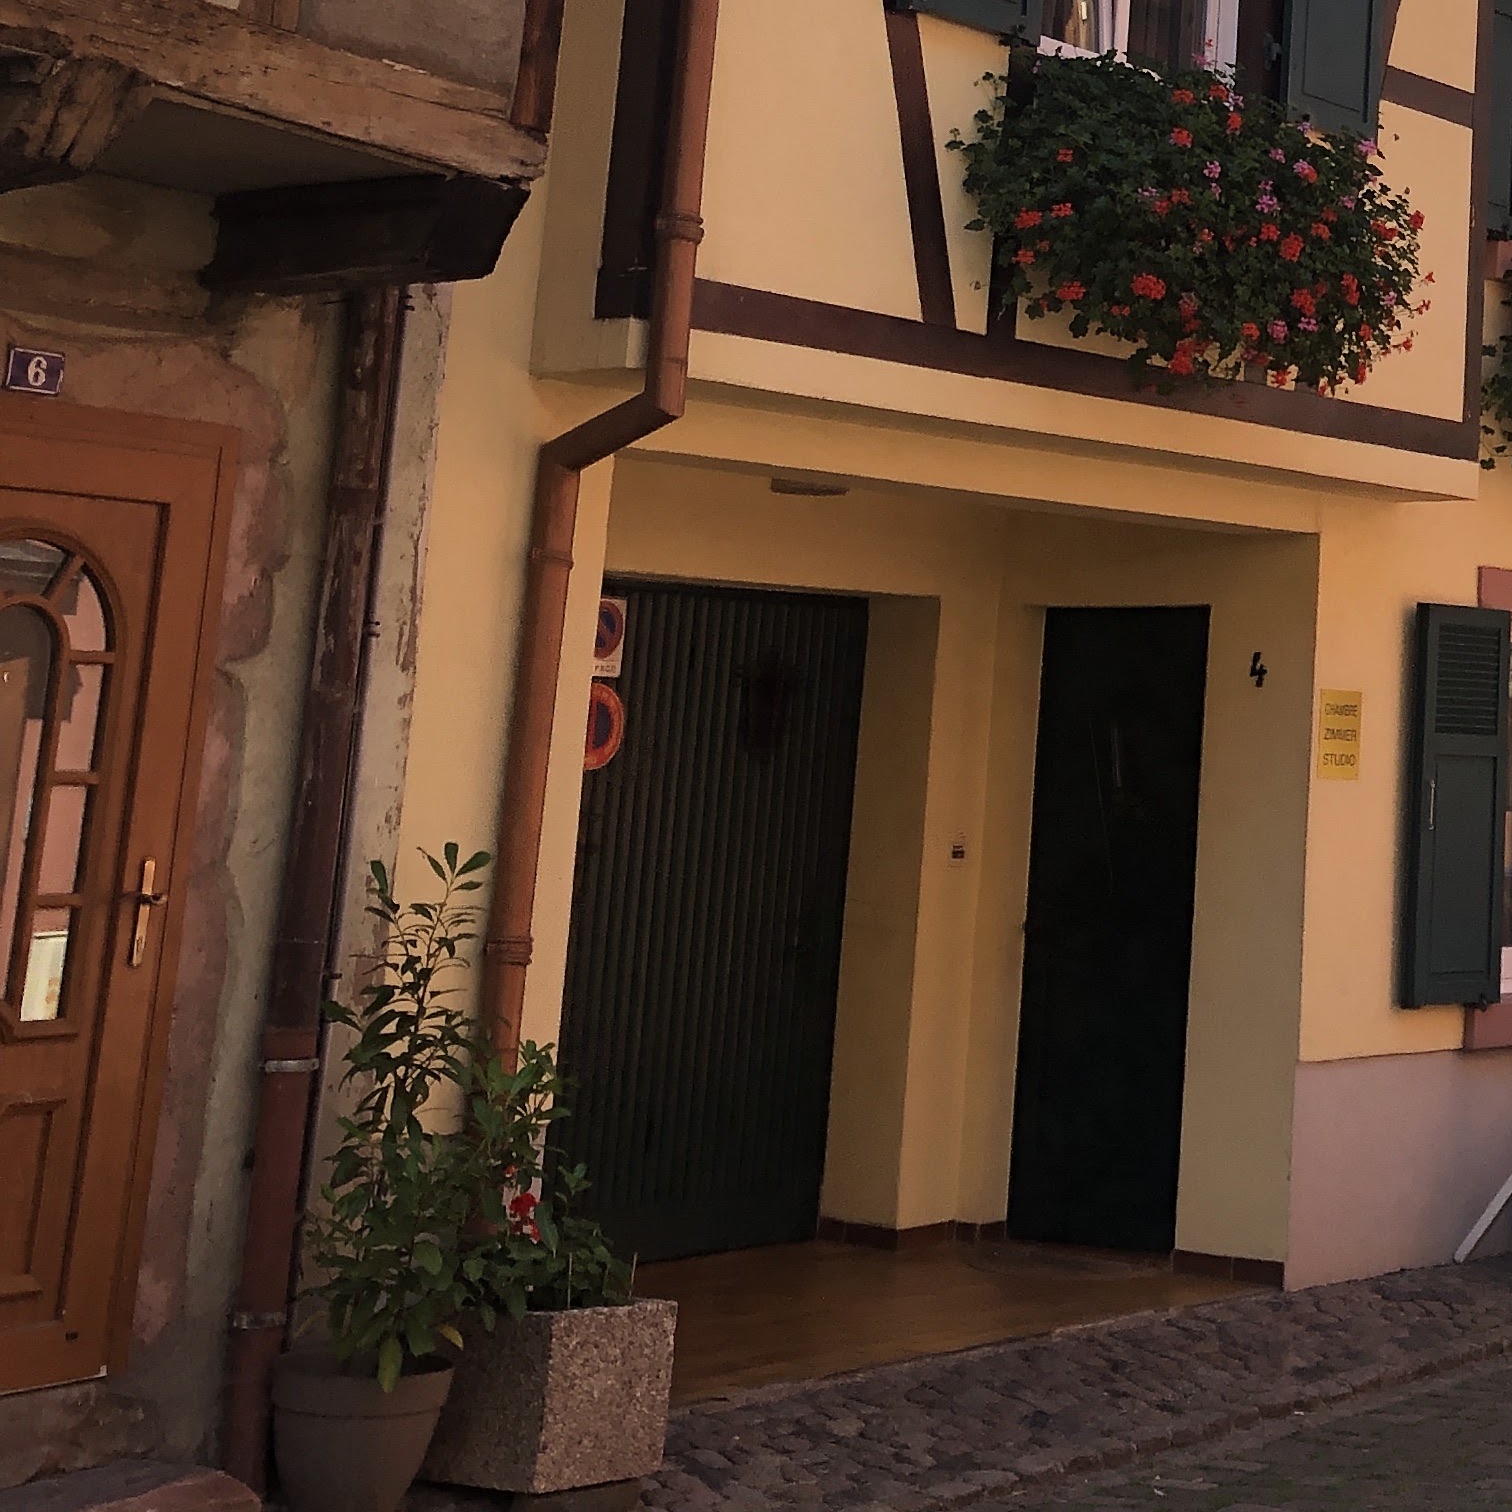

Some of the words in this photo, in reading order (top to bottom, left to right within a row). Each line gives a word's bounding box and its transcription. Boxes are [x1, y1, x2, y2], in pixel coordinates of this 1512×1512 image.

[27, 356, 48, 387] 6
[1249, 651, 1268, 688] 4
[1323, 727, 1358, 742] ZIMMER
[1323, 753, 1357, 767] STUDIO
